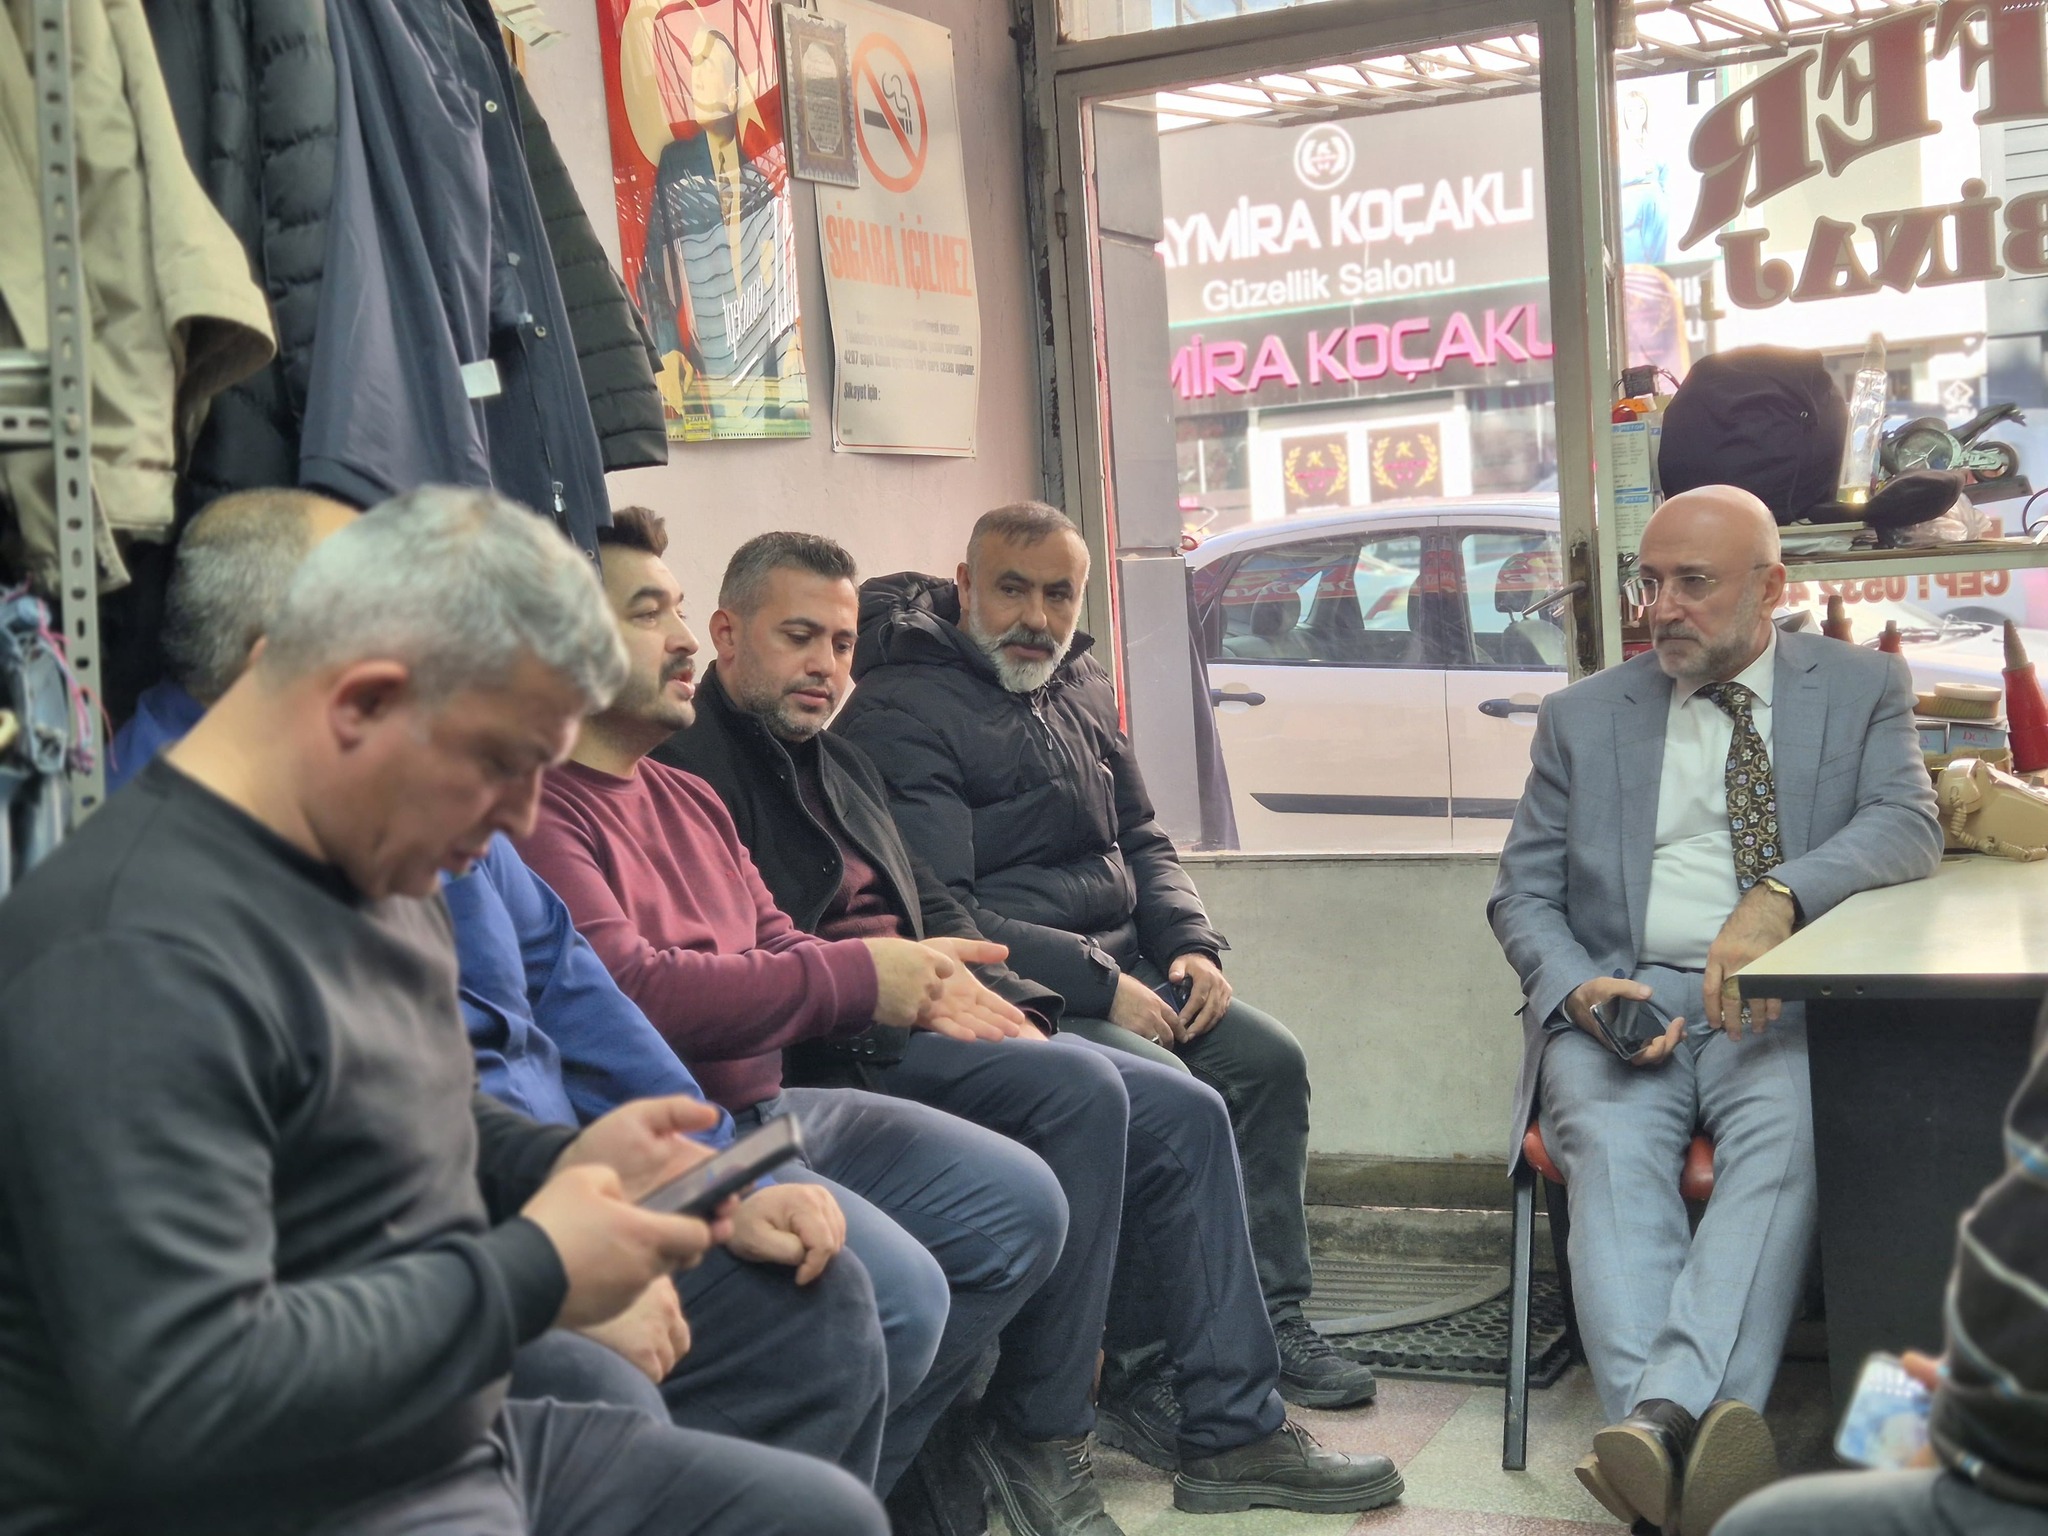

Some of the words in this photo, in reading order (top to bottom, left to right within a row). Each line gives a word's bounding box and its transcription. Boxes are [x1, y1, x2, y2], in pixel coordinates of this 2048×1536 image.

[1330, 167, 1534, 246] KOÇAKLI
[826, 201, 900, 288] SİGARA
[900, 212, 972, 300] İÇİLMEZ
[1202, 267, 1331, 312] Güzellik
[1339, 258, 1456, 295] Salonu
